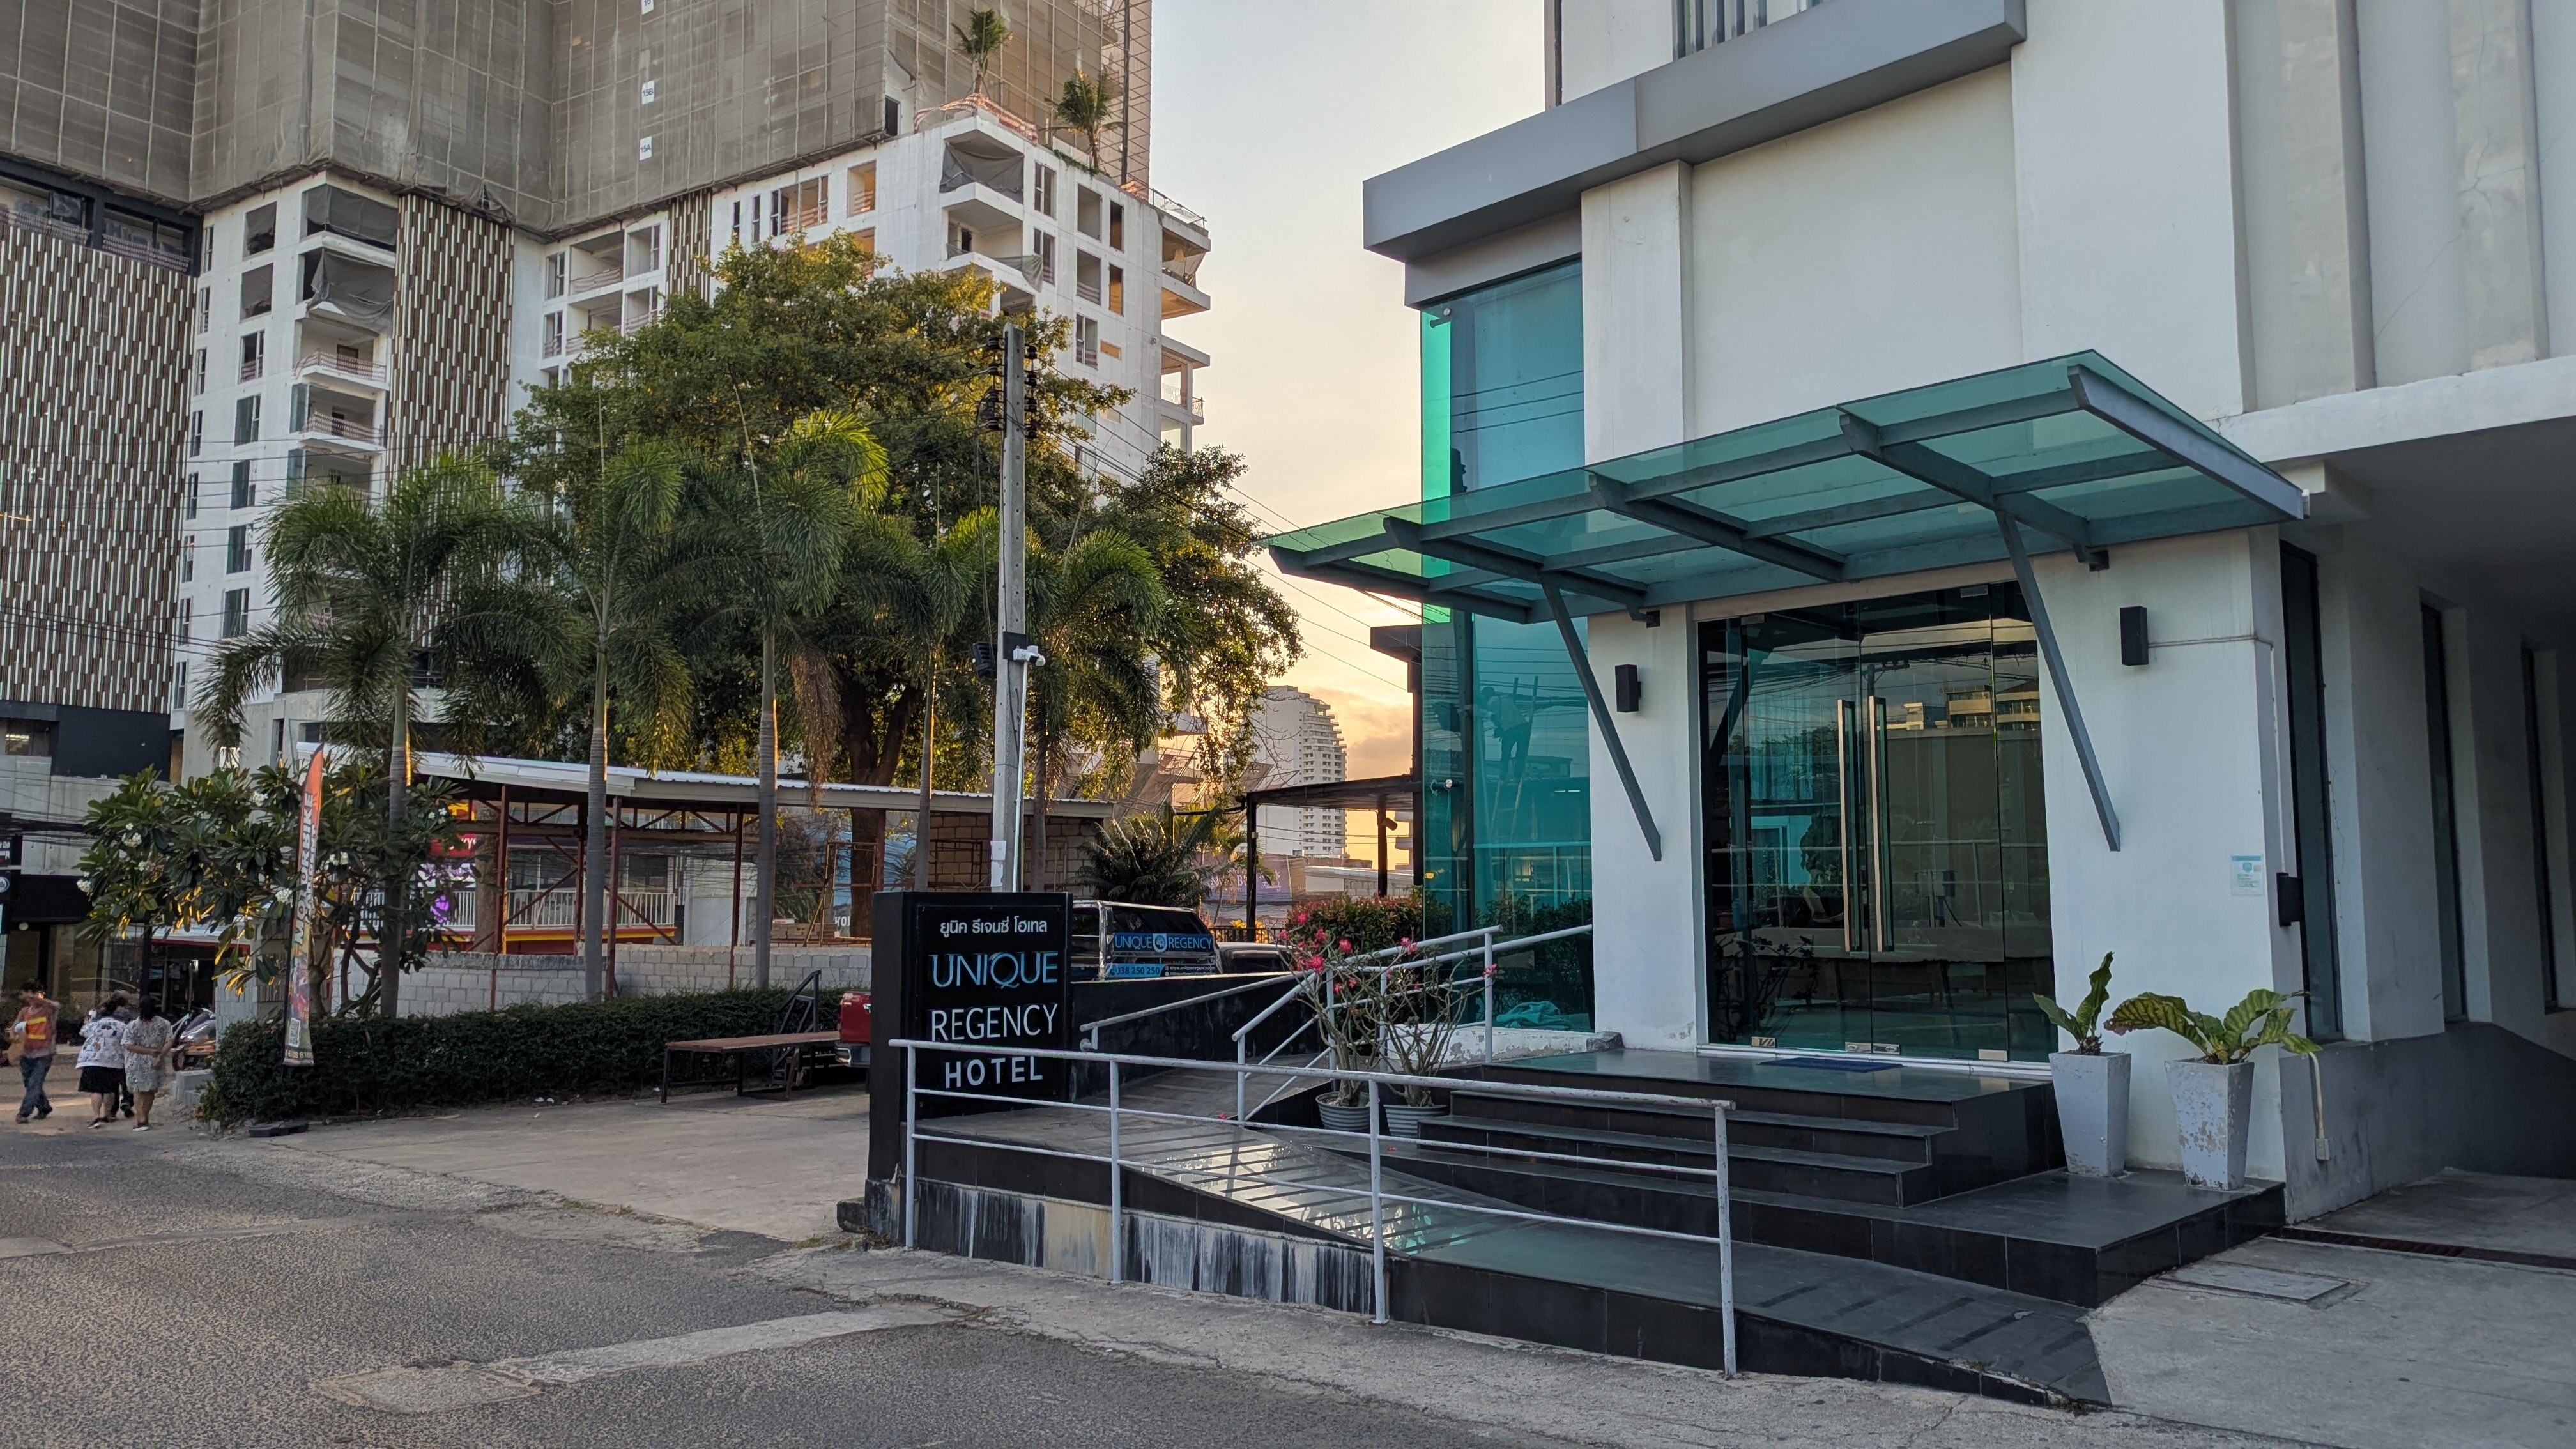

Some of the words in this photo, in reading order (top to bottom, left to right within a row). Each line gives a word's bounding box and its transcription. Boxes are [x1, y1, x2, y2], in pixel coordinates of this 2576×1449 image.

[643, 88, 654, 96] 15B
[641, 143, 651, 153] 15A
[293, 793, 312, 945] MOTORBIKE
[940, 919, 967, 938] ยูนิค
[972, 916, 1009, 933] รีเจนซี่
[1014, 916, 1048, 933] โฮเทล
[1115, 935, 1152, 949] UNIQUE
[1168, 937, 1212, 949] REGENCY
[931, 951, 1059, 989] UNIQUE
[1131, 966, 1145, 975] 250
[1146, 966, 1160, 975] 250
[931, 1003, 1058, 1042] REGENCY
[945, 1056, 1043, 1089] HOTEL
